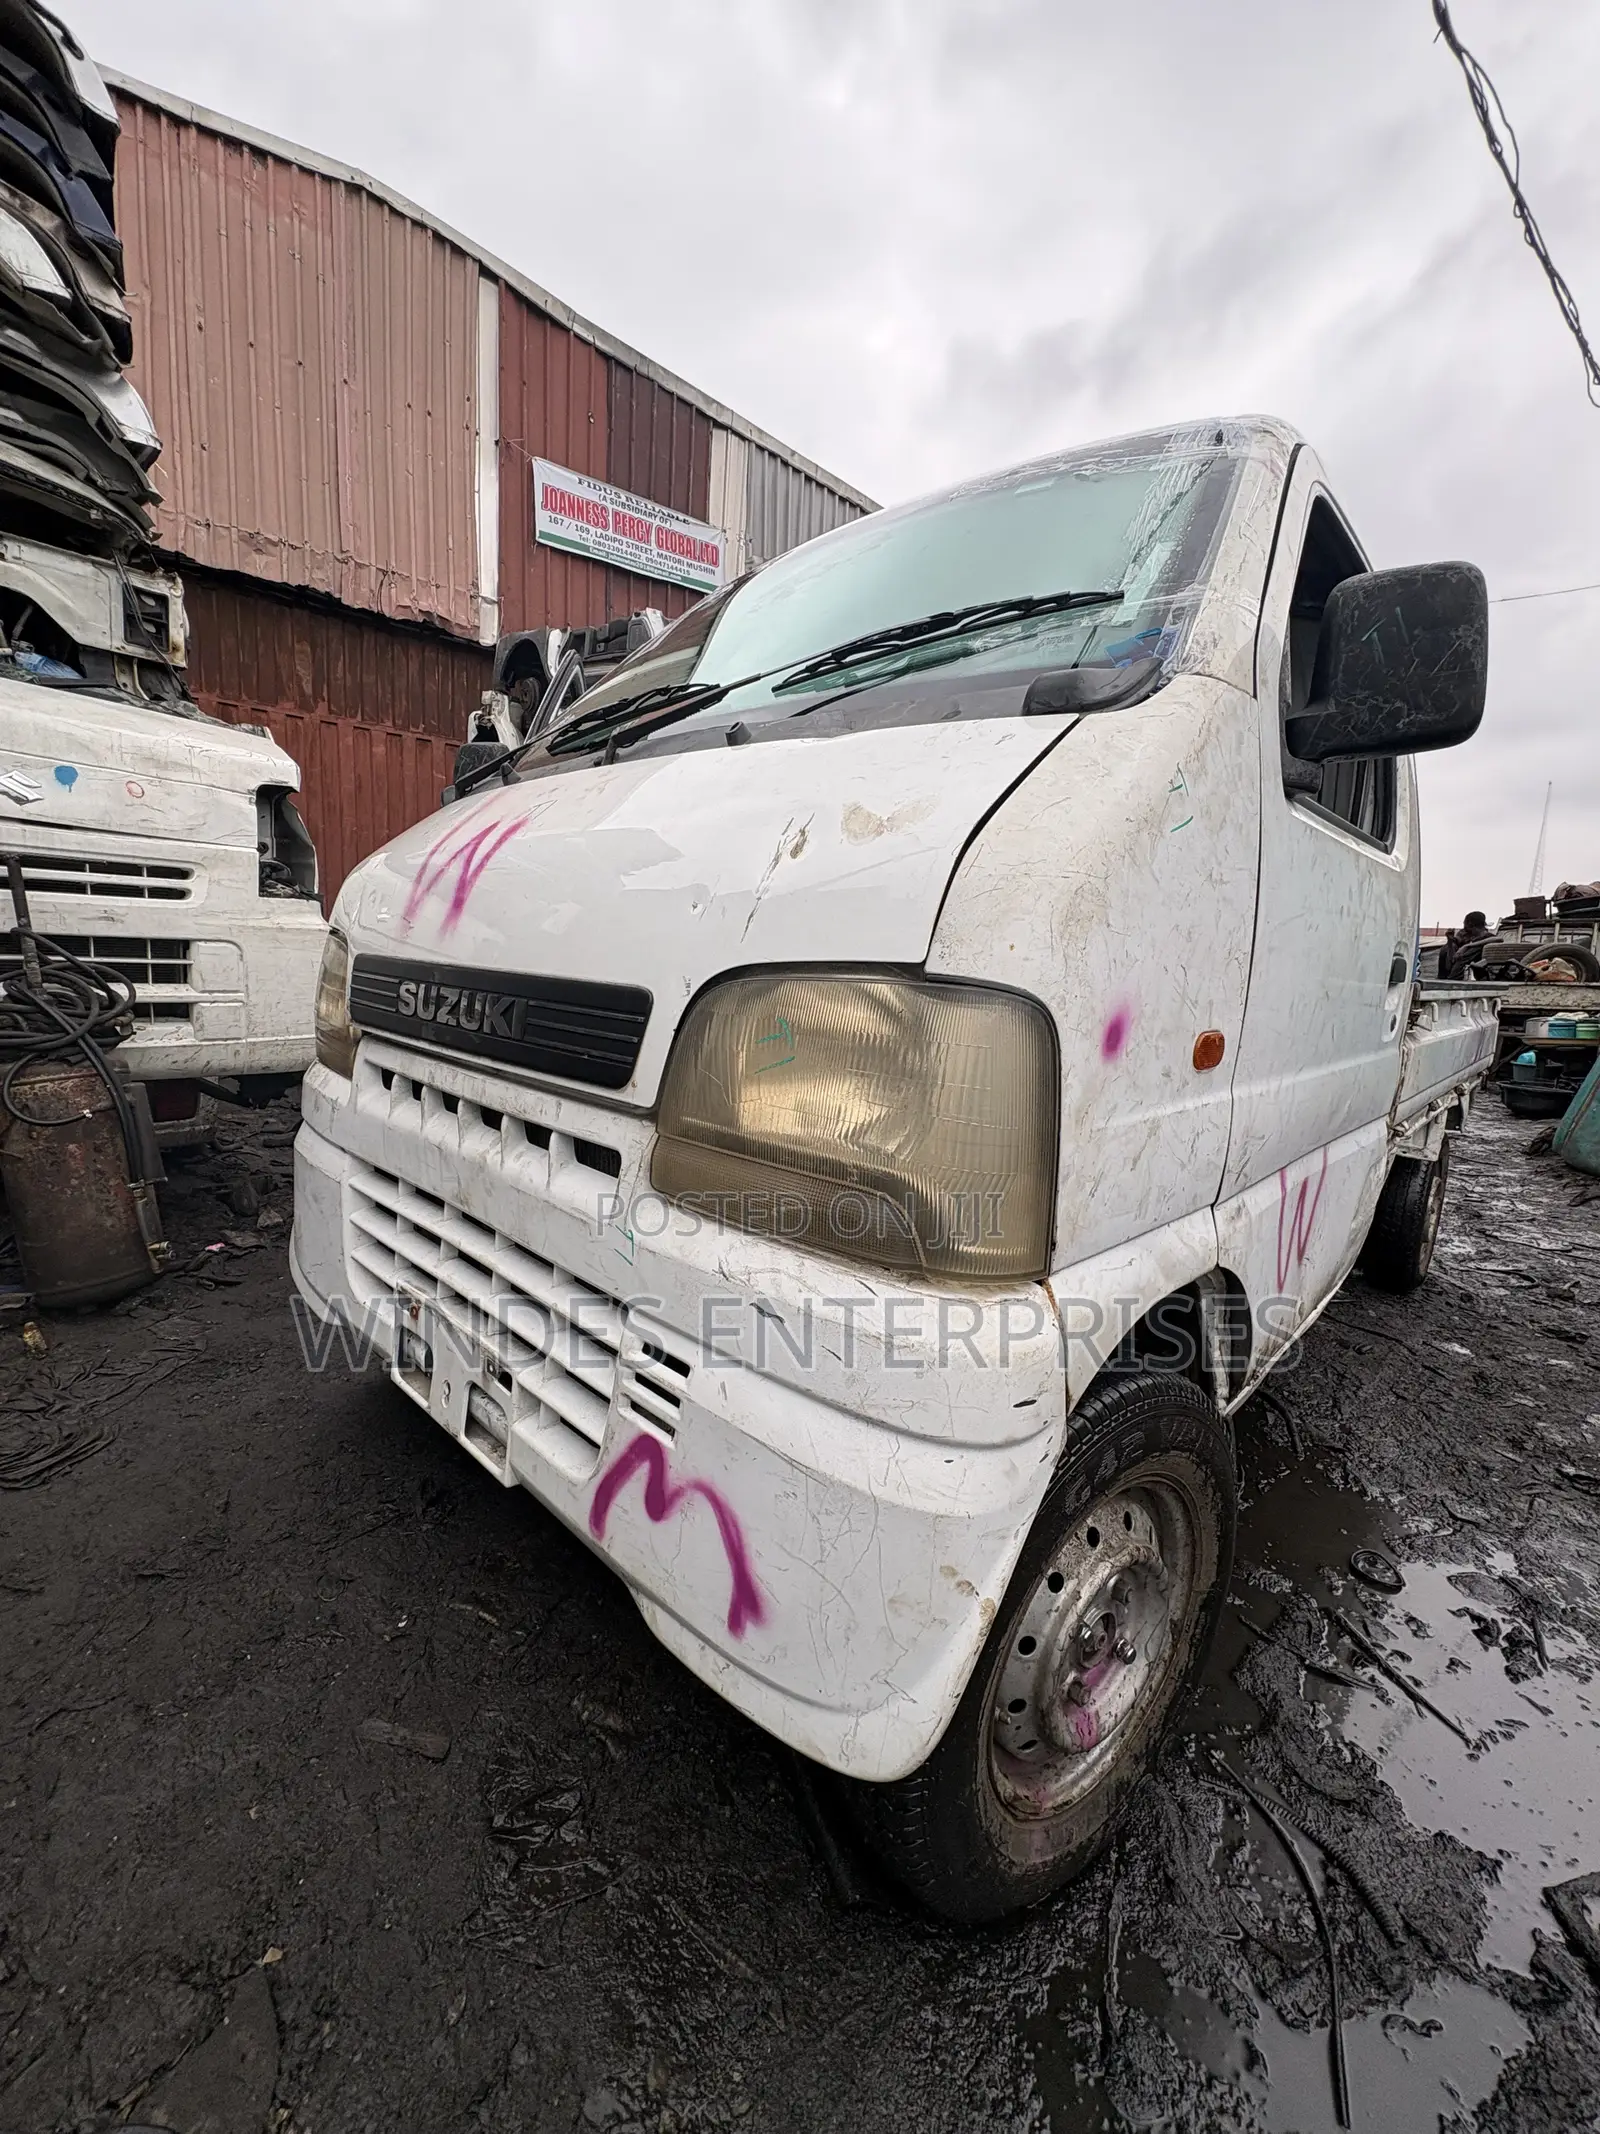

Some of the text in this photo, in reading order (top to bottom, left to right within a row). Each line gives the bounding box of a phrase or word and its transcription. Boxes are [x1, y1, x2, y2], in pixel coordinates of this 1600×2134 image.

[577, 477, 622, 499] FIDUS
[541, 482, 611, 532] JOANNESS
[611, 507, 654, 547] PERCY
[609, 497, 659, 522] SUBSIDIARY
[659, 515, 673, 528] OF)
[548, 515, 565, 527] 167
[594, 530, 624, 547] LADIPO
[656, 551, 685, 567] MATORI
[686, 562, 716, 577] MUSHIN
[578, 534, 592, 543] Tel:
[398, 980, 529, 1041] SUZUKI
